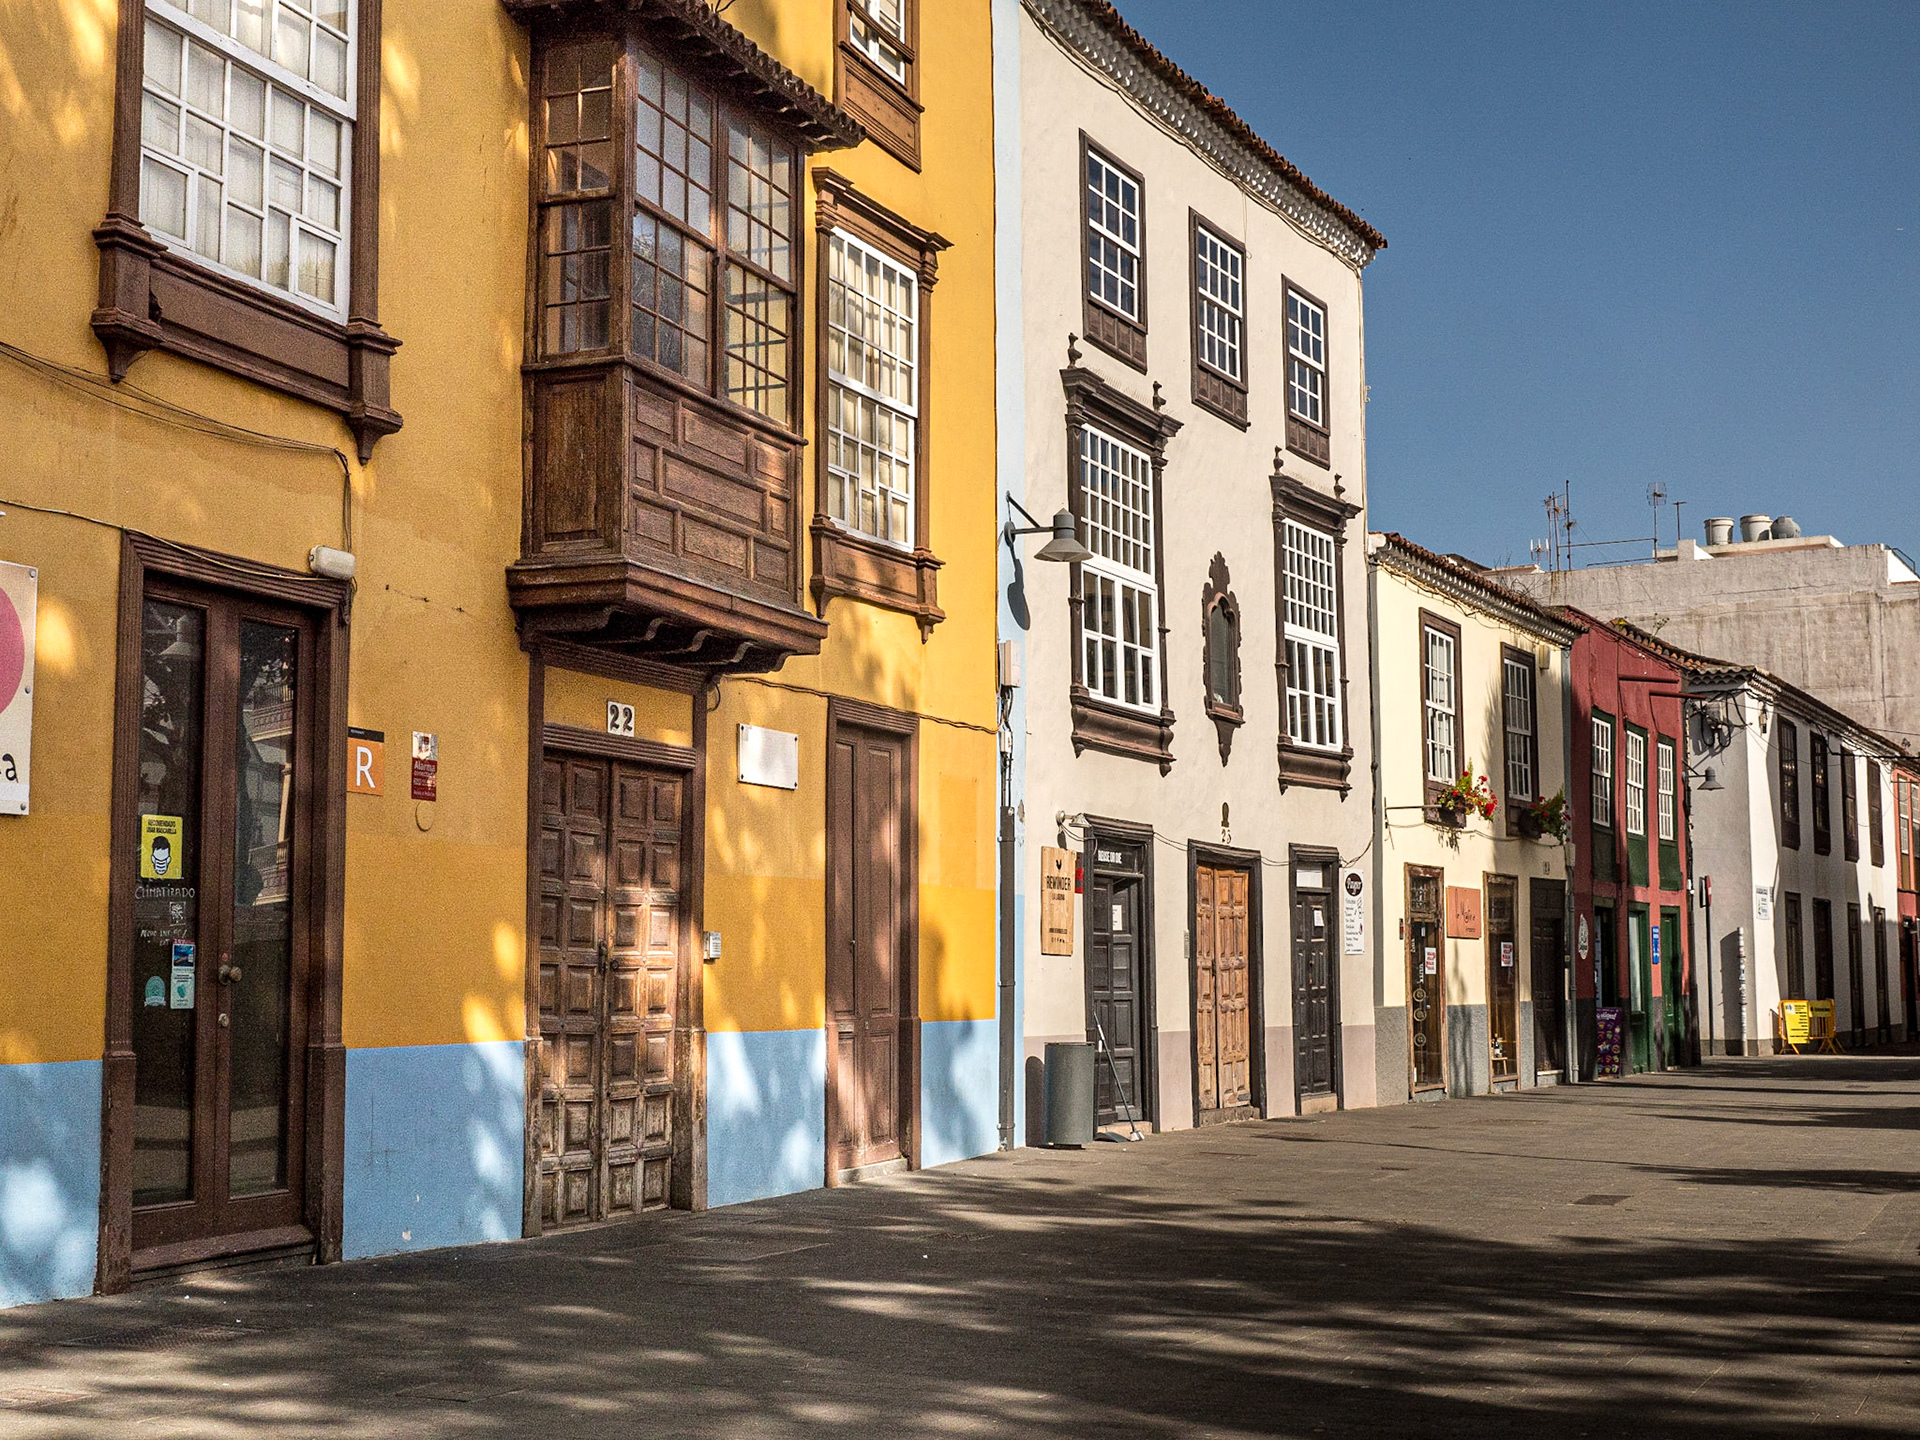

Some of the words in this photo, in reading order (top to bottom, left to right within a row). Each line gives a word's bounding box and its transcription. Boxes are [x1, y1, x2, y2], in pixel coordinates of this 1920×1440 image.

[610, 704, 632, 732] 22
[356, 746, 375, 788] R
[414, 760, 436, 772] Alarma
[1047, 876, 1071, 890] REWINDER
